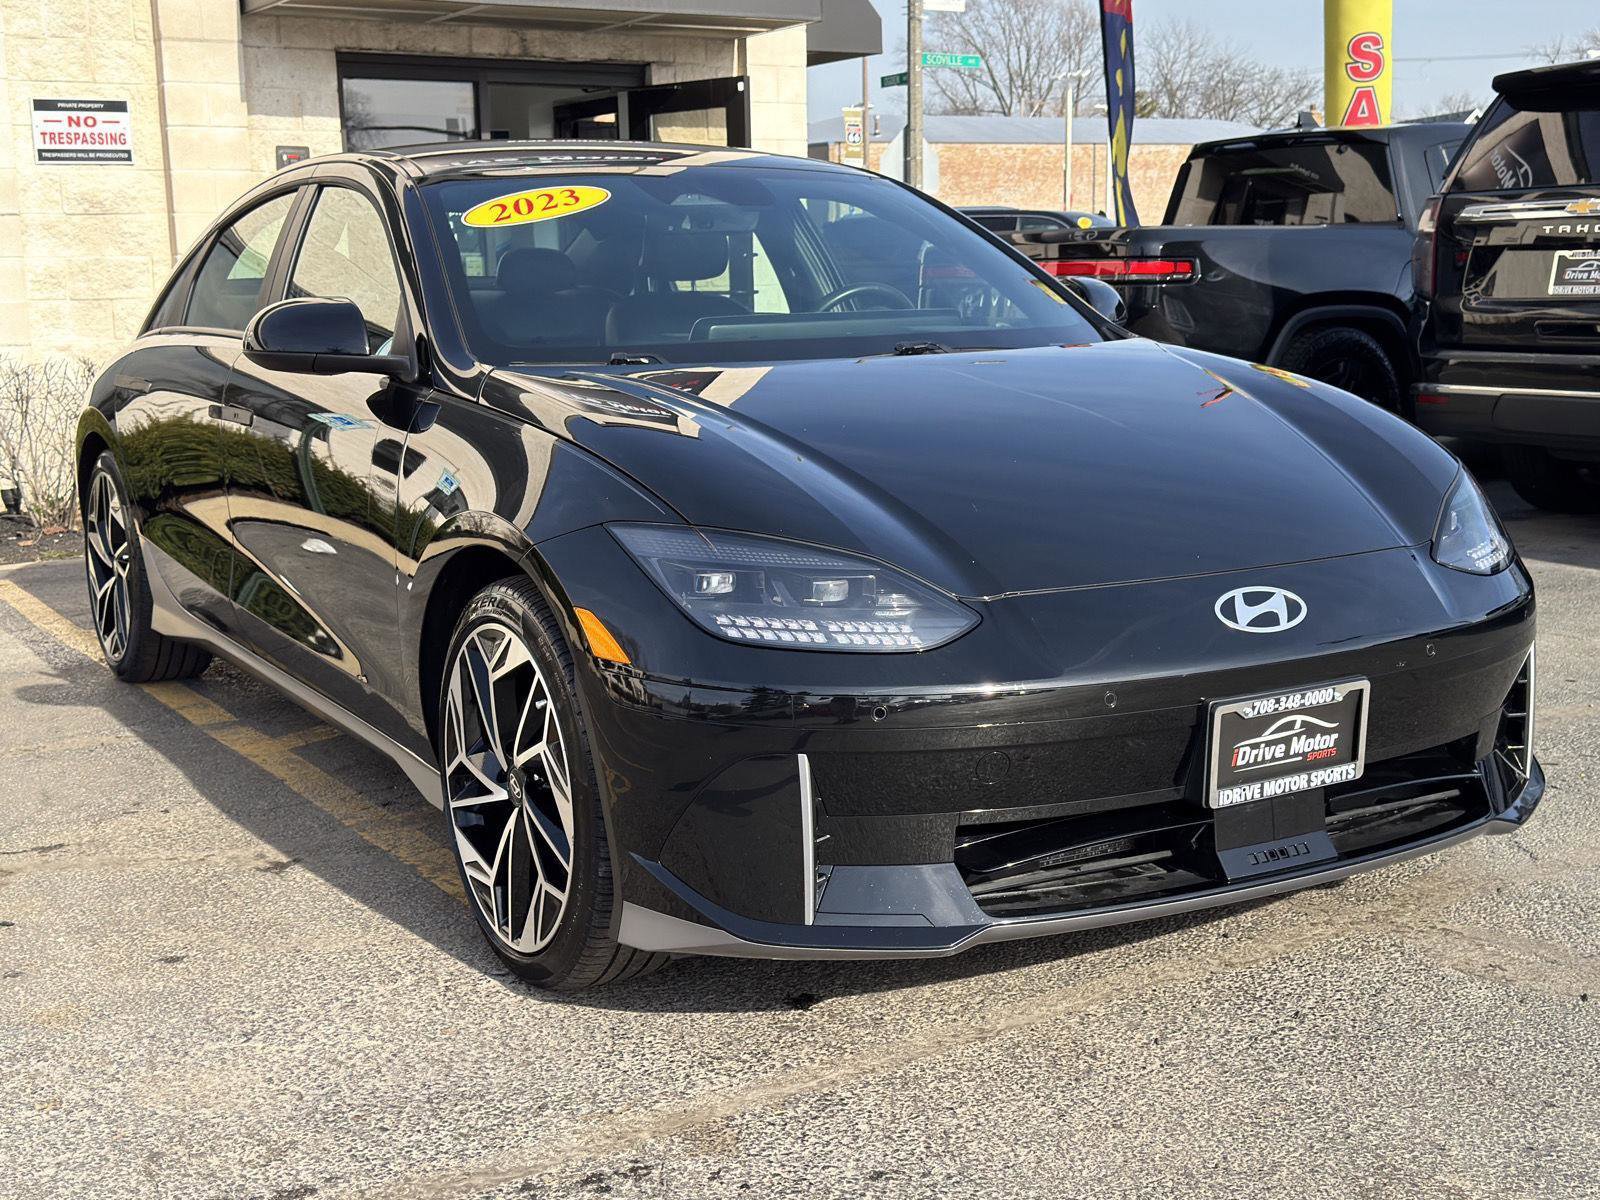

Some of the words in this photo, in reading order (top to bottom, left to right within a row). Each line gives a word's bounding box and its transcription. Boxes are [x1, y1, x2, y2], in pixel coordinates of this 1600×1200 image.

[926, 54, 963, 65] SCOVILLE
[67, 116, 97, 128] NO
[40, 132, 127, 145] TRESPASSING
[489, 189, 580, 222] 2023
[1252, 688, 1335, 715] 708-348-0000
[1231, 743, 1286, 767] iDrive
[1290, 733, 1339, 755] Motor
[1307, 747, 1337, 761] SPORTS
[1218, 785, 1261, 807] IDRIVE
[1263, 774, 1308, 797] MOTOR
[1310, 763, 1356, 786] SPORTS
